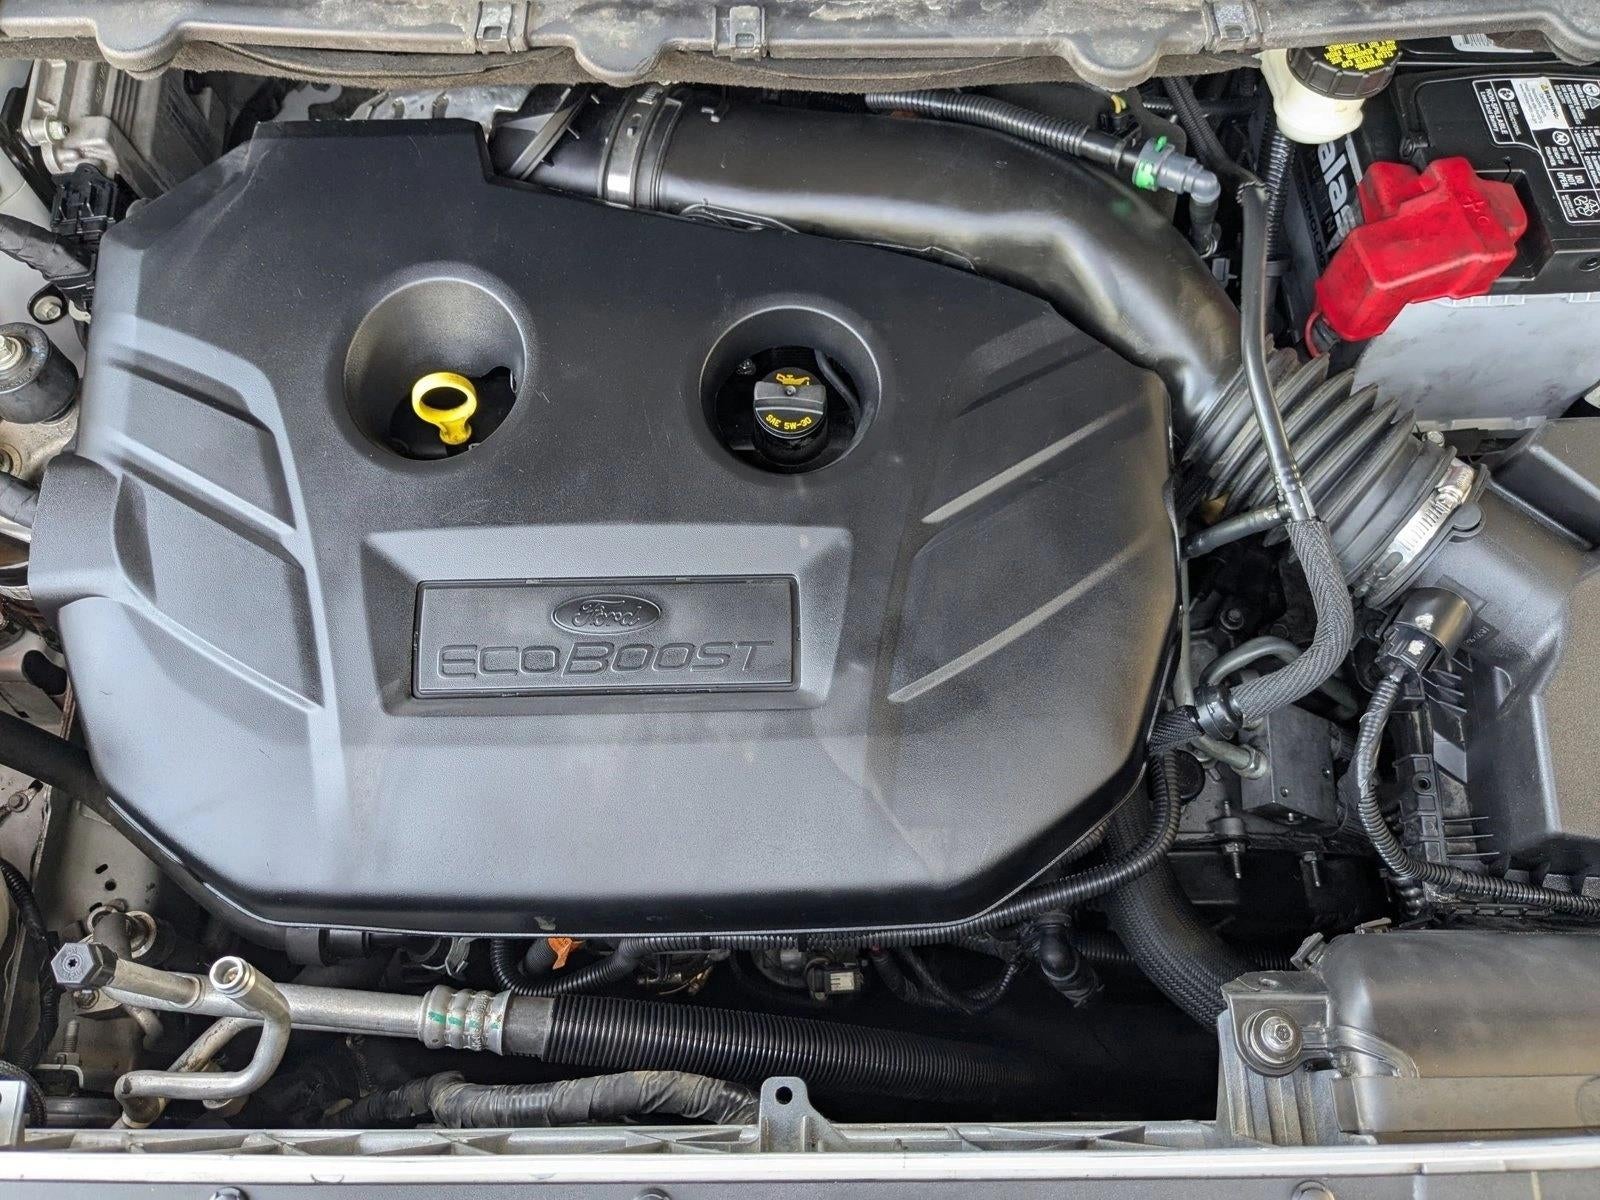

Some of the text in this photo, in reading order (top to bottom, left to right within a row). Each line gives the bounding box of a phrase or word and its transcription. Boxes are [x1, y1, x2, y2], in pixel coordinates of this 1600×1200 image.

[1480, 92, 1489, 103] Lead
[1486, 89, 1509, 135] NON-SPILLABLE
[1557, 173, 1569, 189] OPEN.
[1567, 174, 1577, 186] NOT
[1575, 175, 1584, 184] DO
[766, 414, 812, 430] SAE 5W-30
[572, 600, 640, 628] Ford
[437, 640, 774, 679] ECOBOOST
